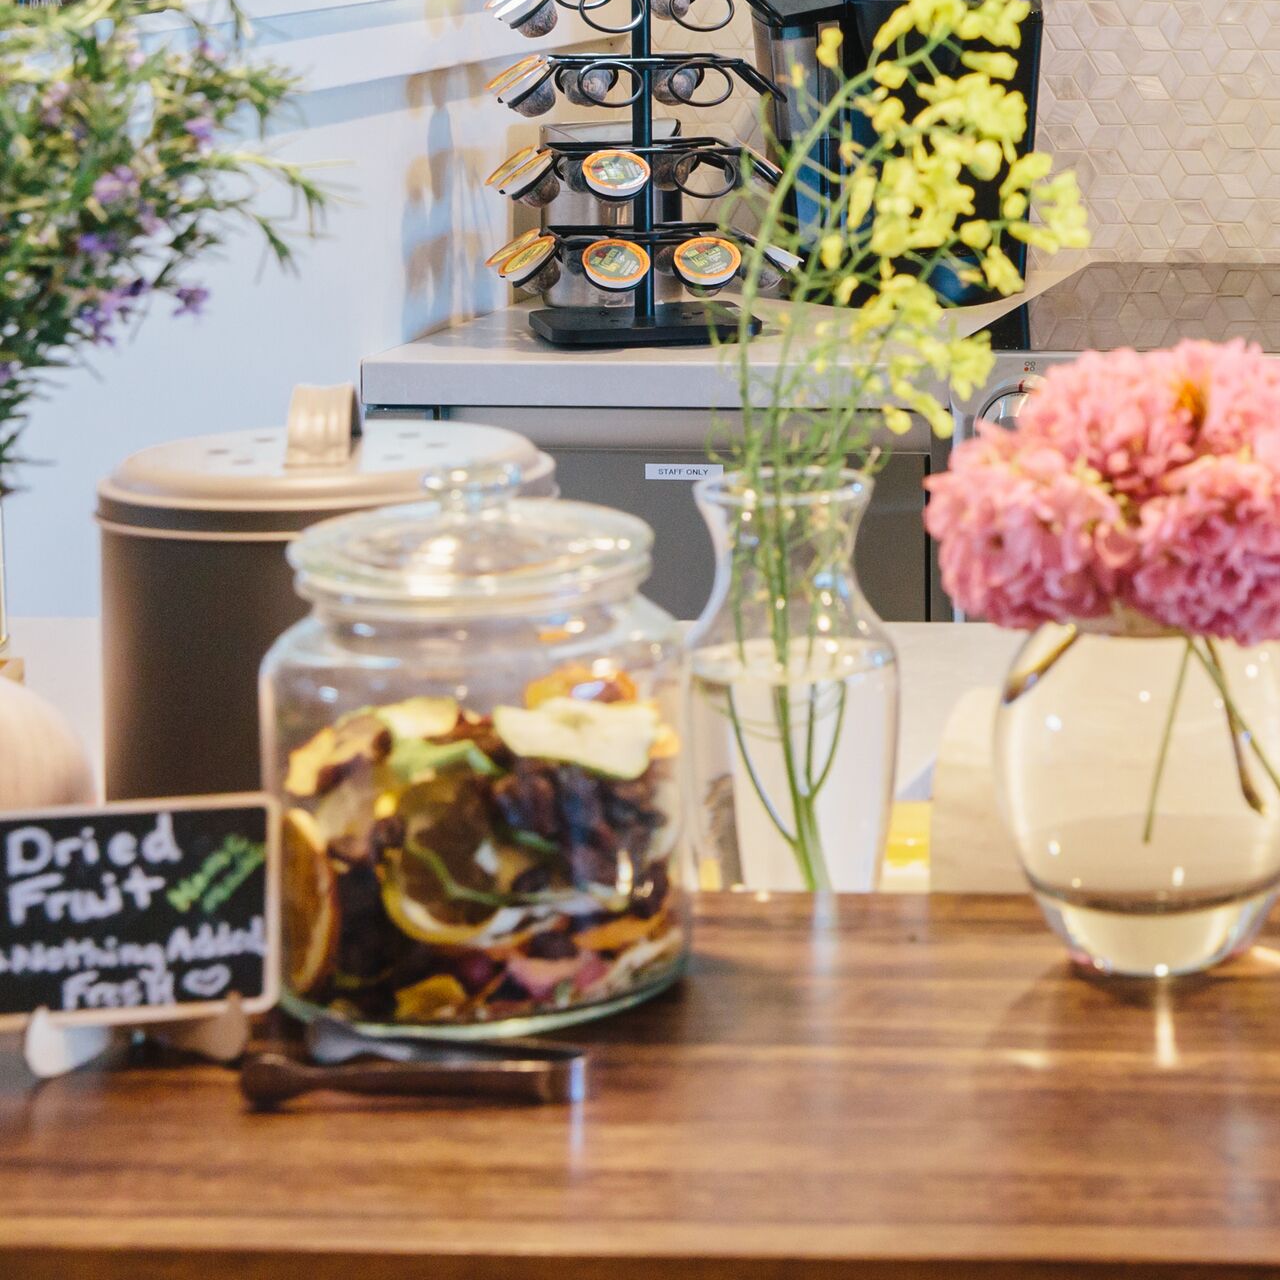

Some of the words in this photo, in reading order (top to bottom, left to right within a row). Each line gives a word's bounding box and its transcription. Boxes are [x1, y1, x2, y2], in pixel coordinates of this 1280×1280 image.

[686, 468, 709, 476] ONLY
[6, 812, 182, 876] Dried
[8, 865, 166, 926] Fruit
